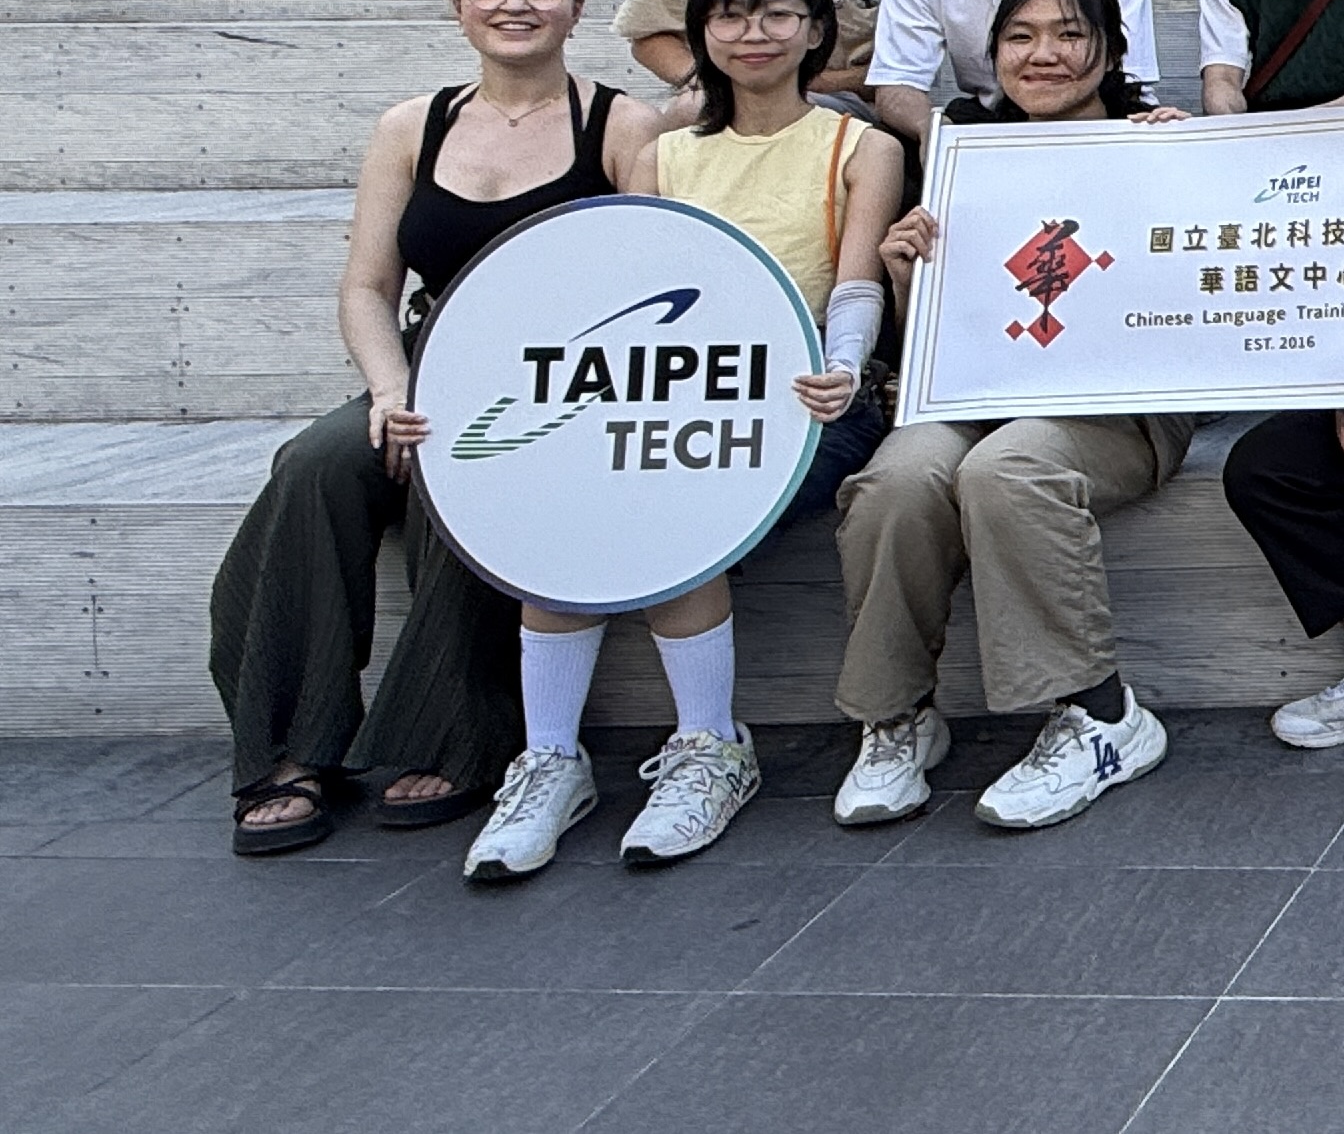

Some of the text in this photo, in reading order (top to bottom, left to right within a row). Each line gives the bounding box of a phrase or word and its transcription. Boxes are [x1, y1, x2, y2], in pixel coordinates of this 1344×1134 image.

[1269, 175, 1322, 191] TAIPEI
[1286, 191, 1320, 204] TECH
[1125, 312, 1193, 328] Chinese
[1202, 307, 1286, 327] Language
[1244, 335, 1316, 351] EST. 2016
[523, 344, 768, 404] TAIPEI
[606, 419, 764, 471] TECH
[1090, 734, 1121, 782] LA
